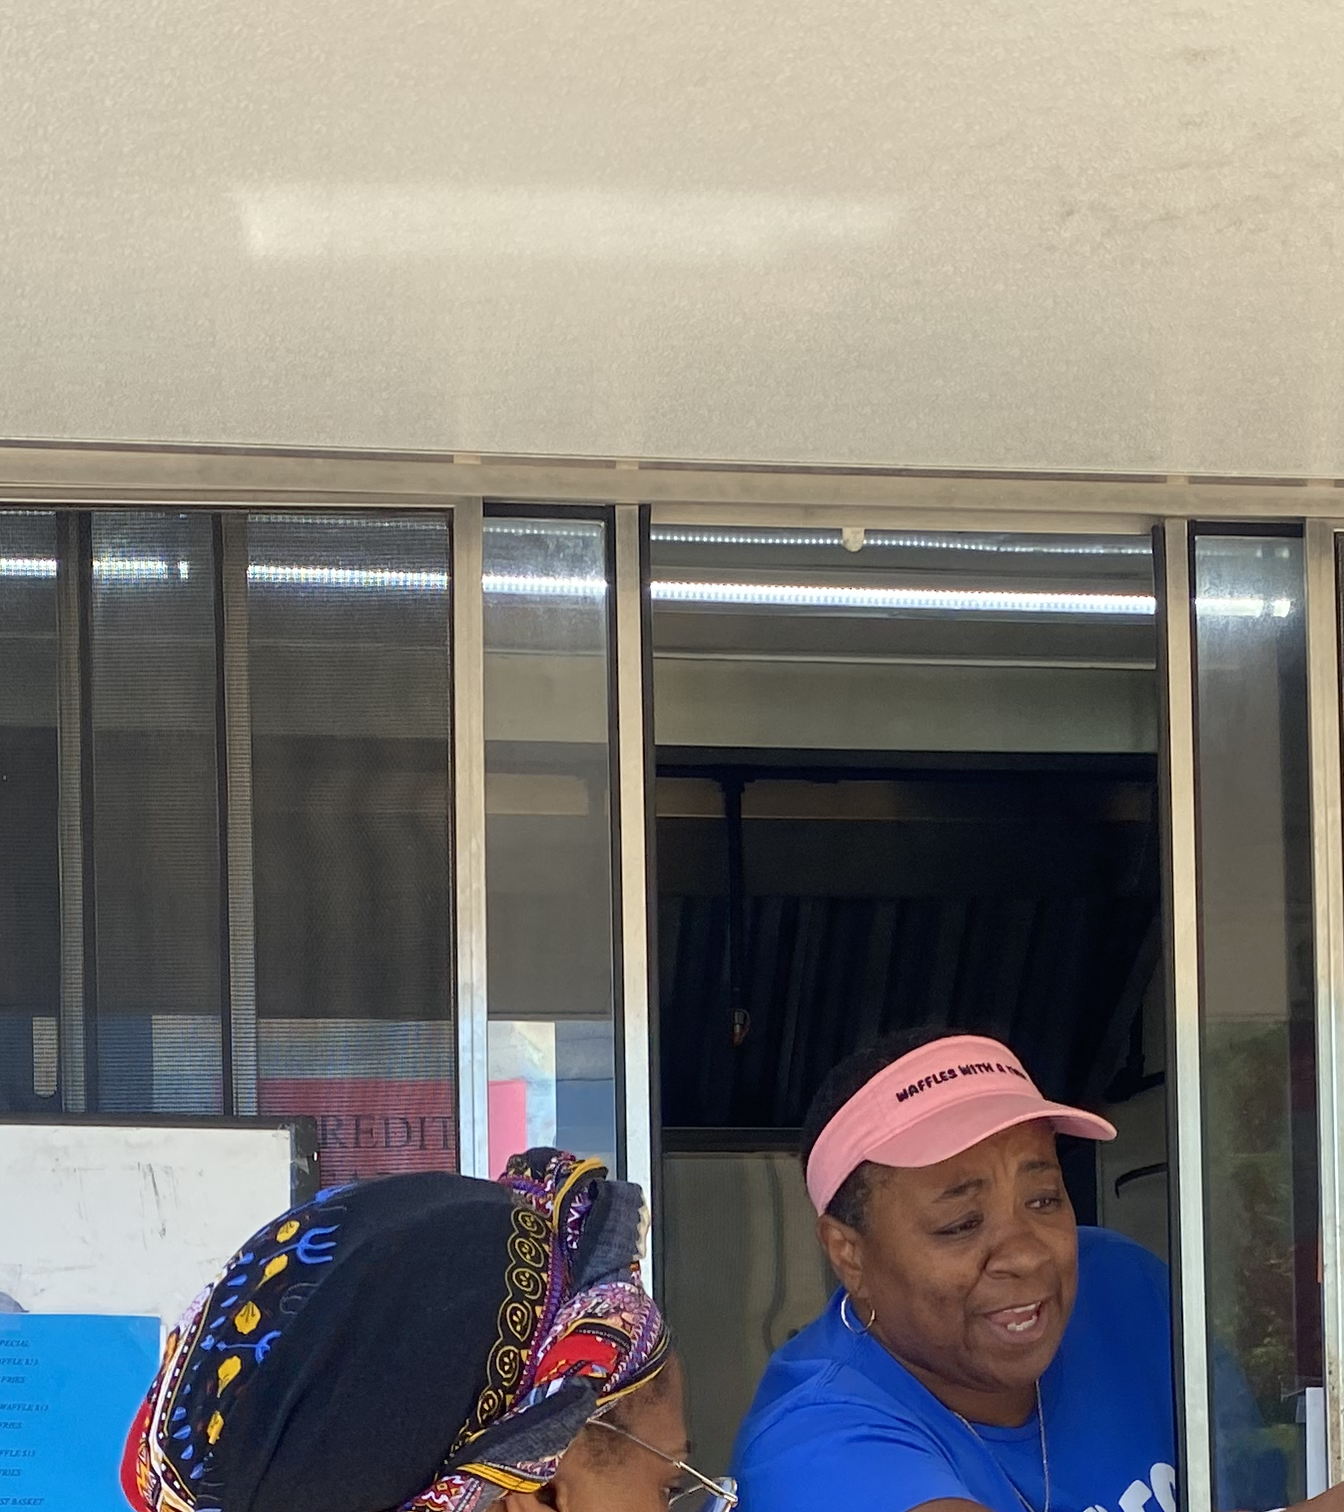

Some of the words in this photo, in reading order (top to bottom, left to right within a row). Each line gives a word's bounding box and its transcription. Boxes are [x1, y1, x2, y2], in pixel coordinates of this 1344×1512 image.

[896, 1068, 958, 1102] WAFFLES
[958, 1062, 995, 1076] WITH
[996, 1063, 1007, 1074] A
[1, 1375, 26, 1384] FRIES
[0, 1402, 33, 1412] WAFFLE
[11, 1497, 45, 1506] BASKET
